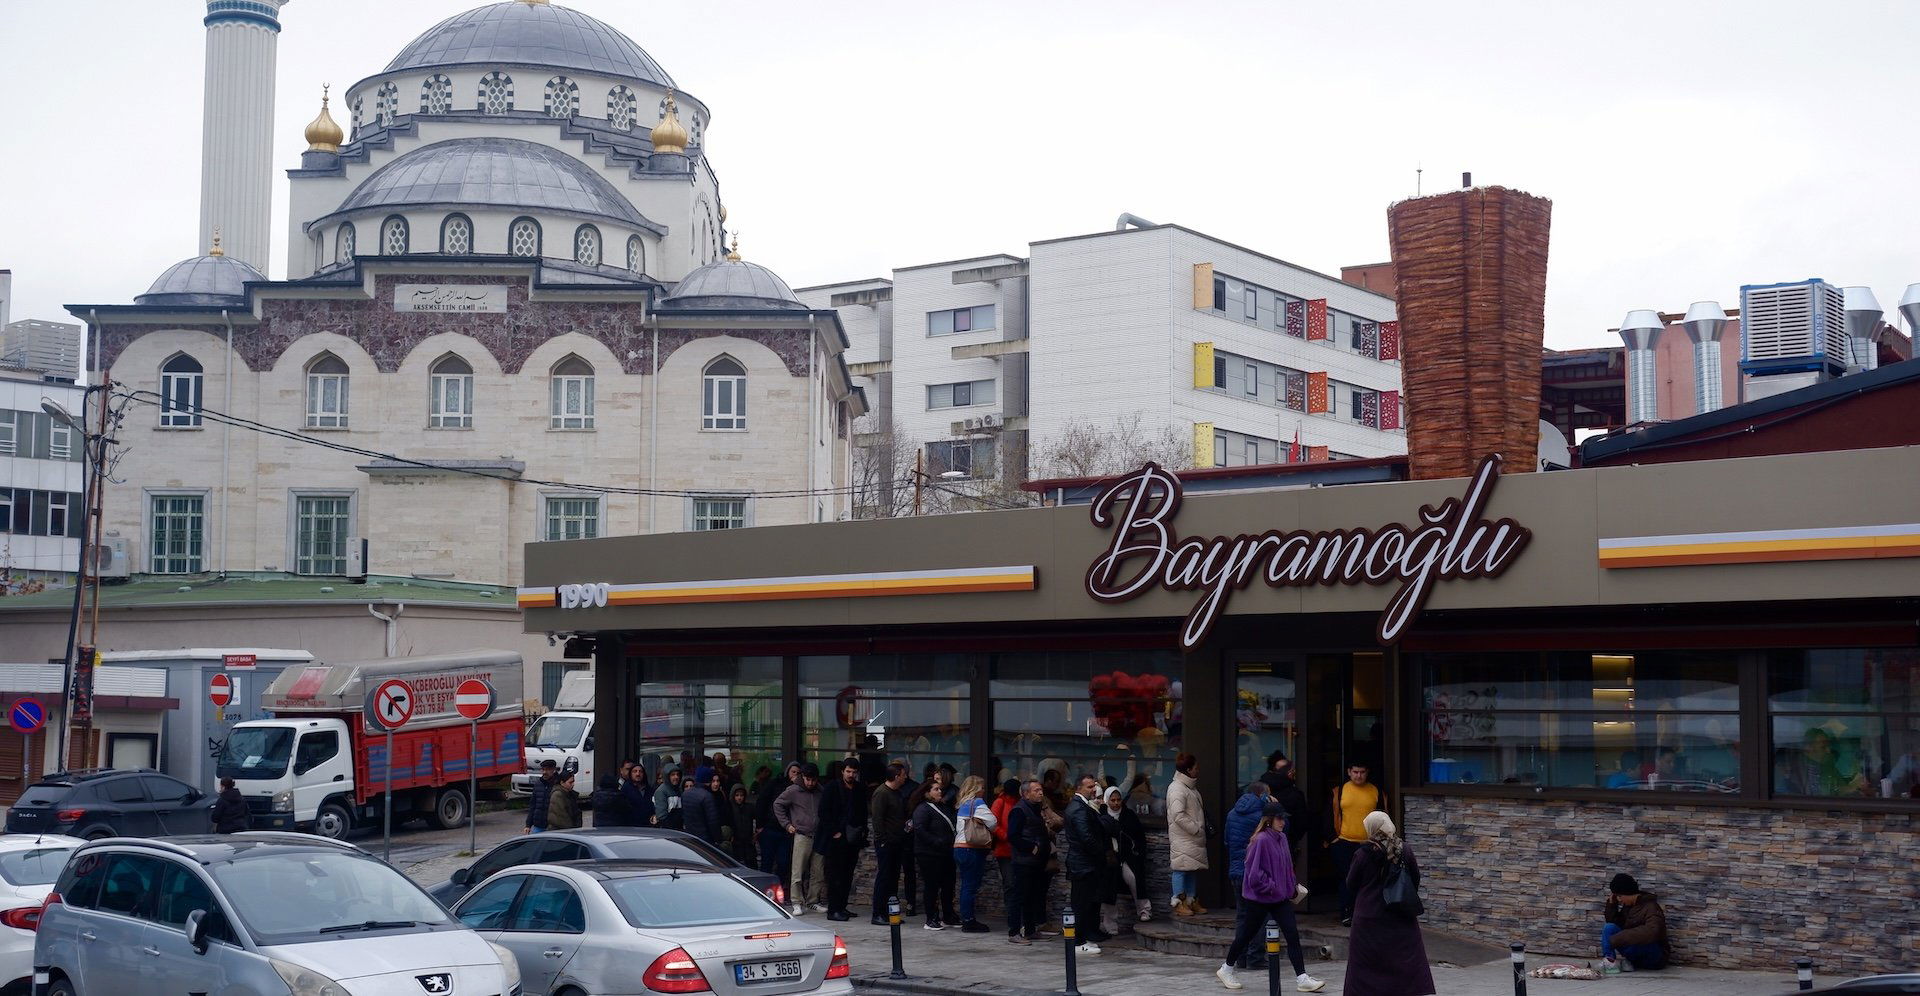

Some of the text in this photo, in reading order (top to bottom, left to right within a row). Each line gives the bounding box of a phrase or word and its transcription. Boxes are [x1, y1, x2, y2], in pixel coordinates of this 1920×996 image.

[1086, 455, 1527, 651] Bayramoğlu
[558, 583, 609, 609] 1990
[426, 693, 435, 702] VE
[743, 962, 799, 979] 34 S 3666
